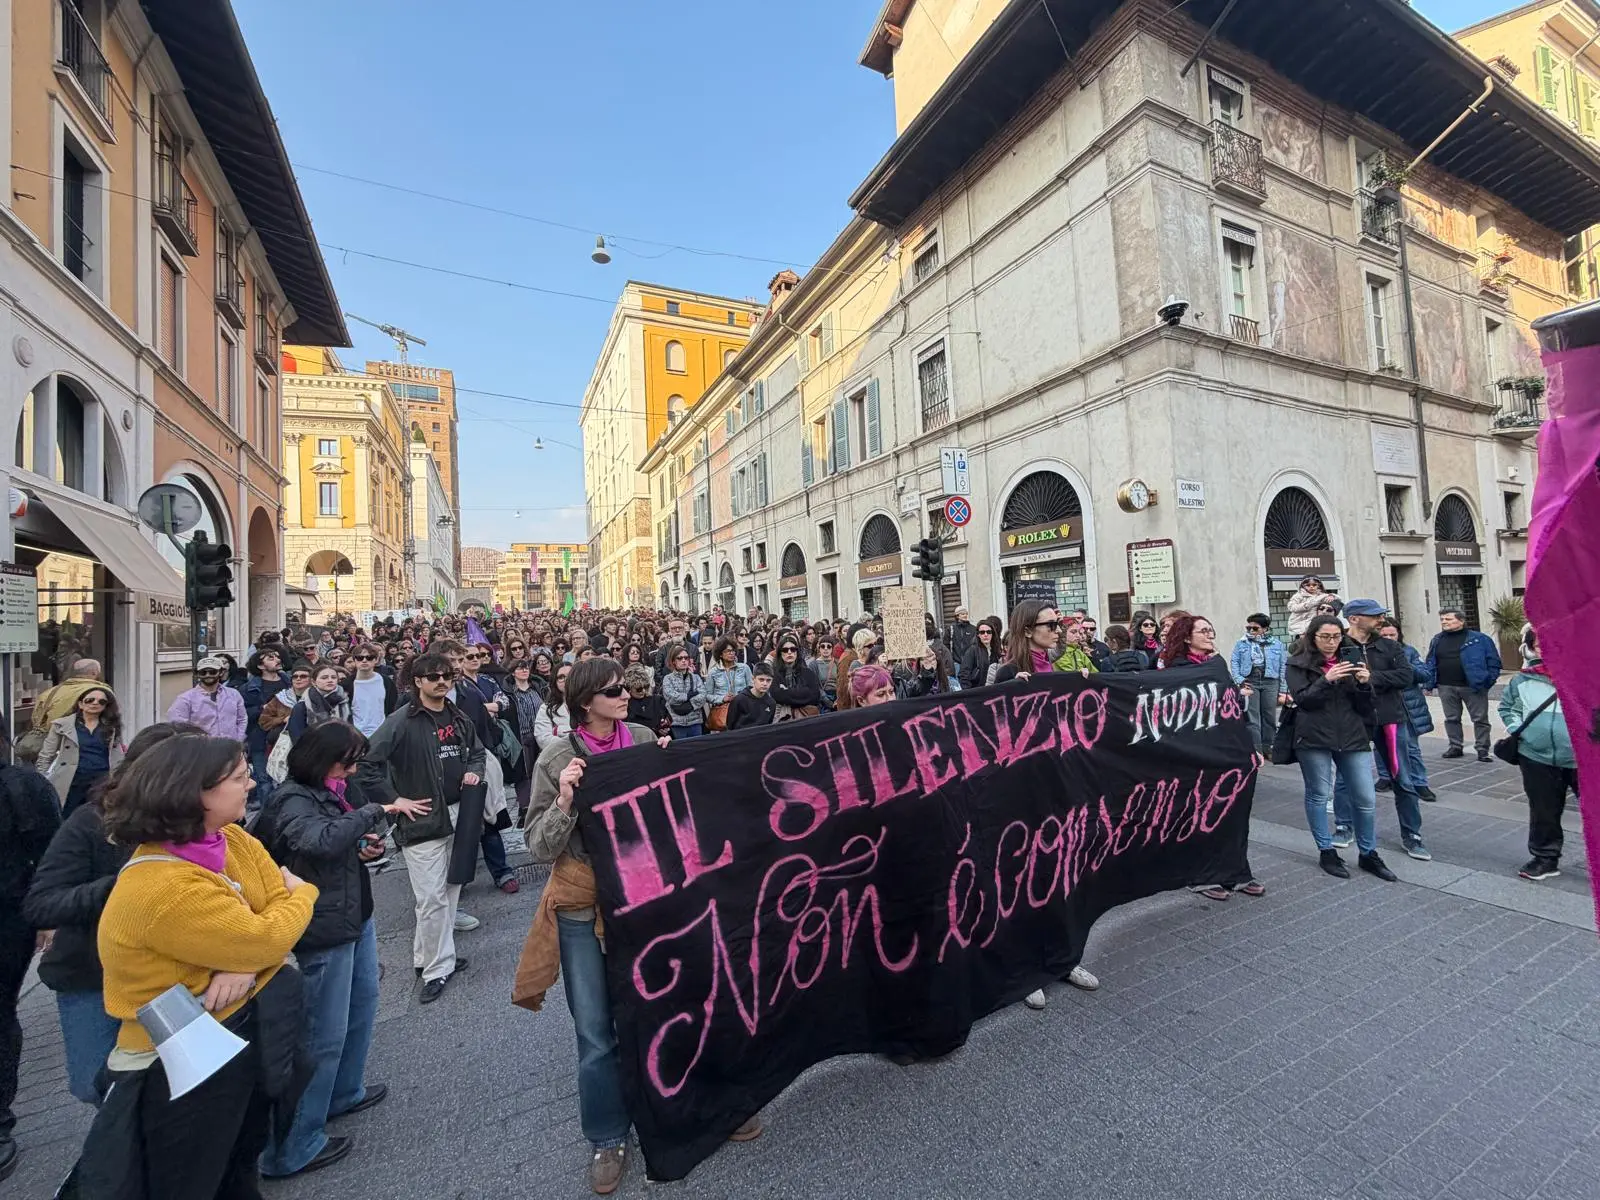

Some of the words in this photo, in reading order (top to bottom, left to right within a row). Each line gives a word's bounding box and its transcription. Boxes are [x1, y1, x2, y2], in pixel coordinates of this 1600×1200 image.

[1180, 482, 1201, 492] CORSO
[1178, 498, 1206, 507] PALESTRO
[1017, 527, 1058, 545] ROLEX
[1281, 556, 1321, 568] VESCHETTI
[592, 767, 733, 915] IL
[761, 687, 1109, 842] SILENZIO
[632, 827, 918, 1099] Non
